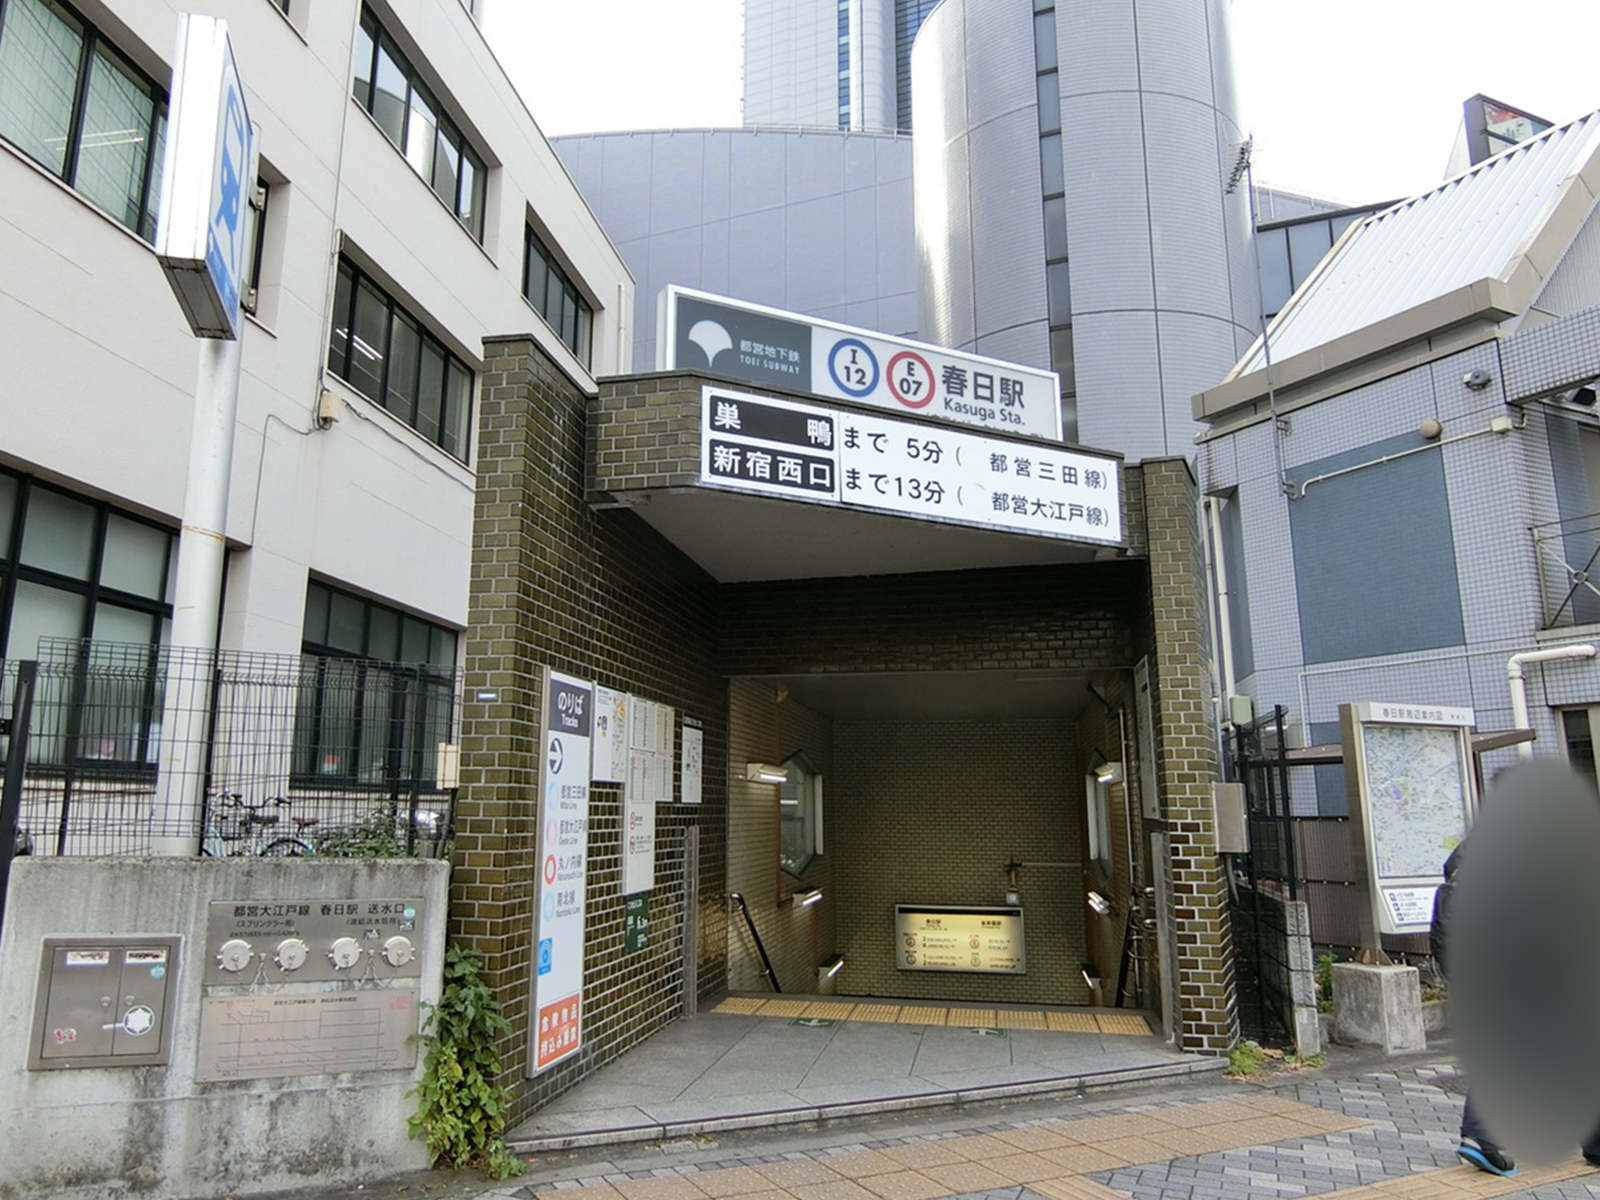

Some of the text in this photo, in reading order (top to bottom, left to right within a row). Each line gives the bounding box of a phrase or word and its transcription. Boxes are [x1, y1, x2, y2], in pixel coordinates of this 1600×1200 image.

[740, 339, 800, 363] 都営地下鉄
[740, 354, 800, 375] TOEI SUBWAY
[844, 366, 866, 385] 12
[907, 361, 915, 377] E
[900, 378, 922, 396] 07
[942, 365, 1025, 409] 春日駅
[944, 397, 995, 421] Kasuga
[1000, 408, 1026, 425] Sta.
[713, 445, 830, 487] 新宿西口
[558, 692, 584, 715] のりば
[234, 904, 310, 917] 都営大江戸線
[320, 904, 358, 916] 春日駅
[368, 903, 405, 914] 送水口
